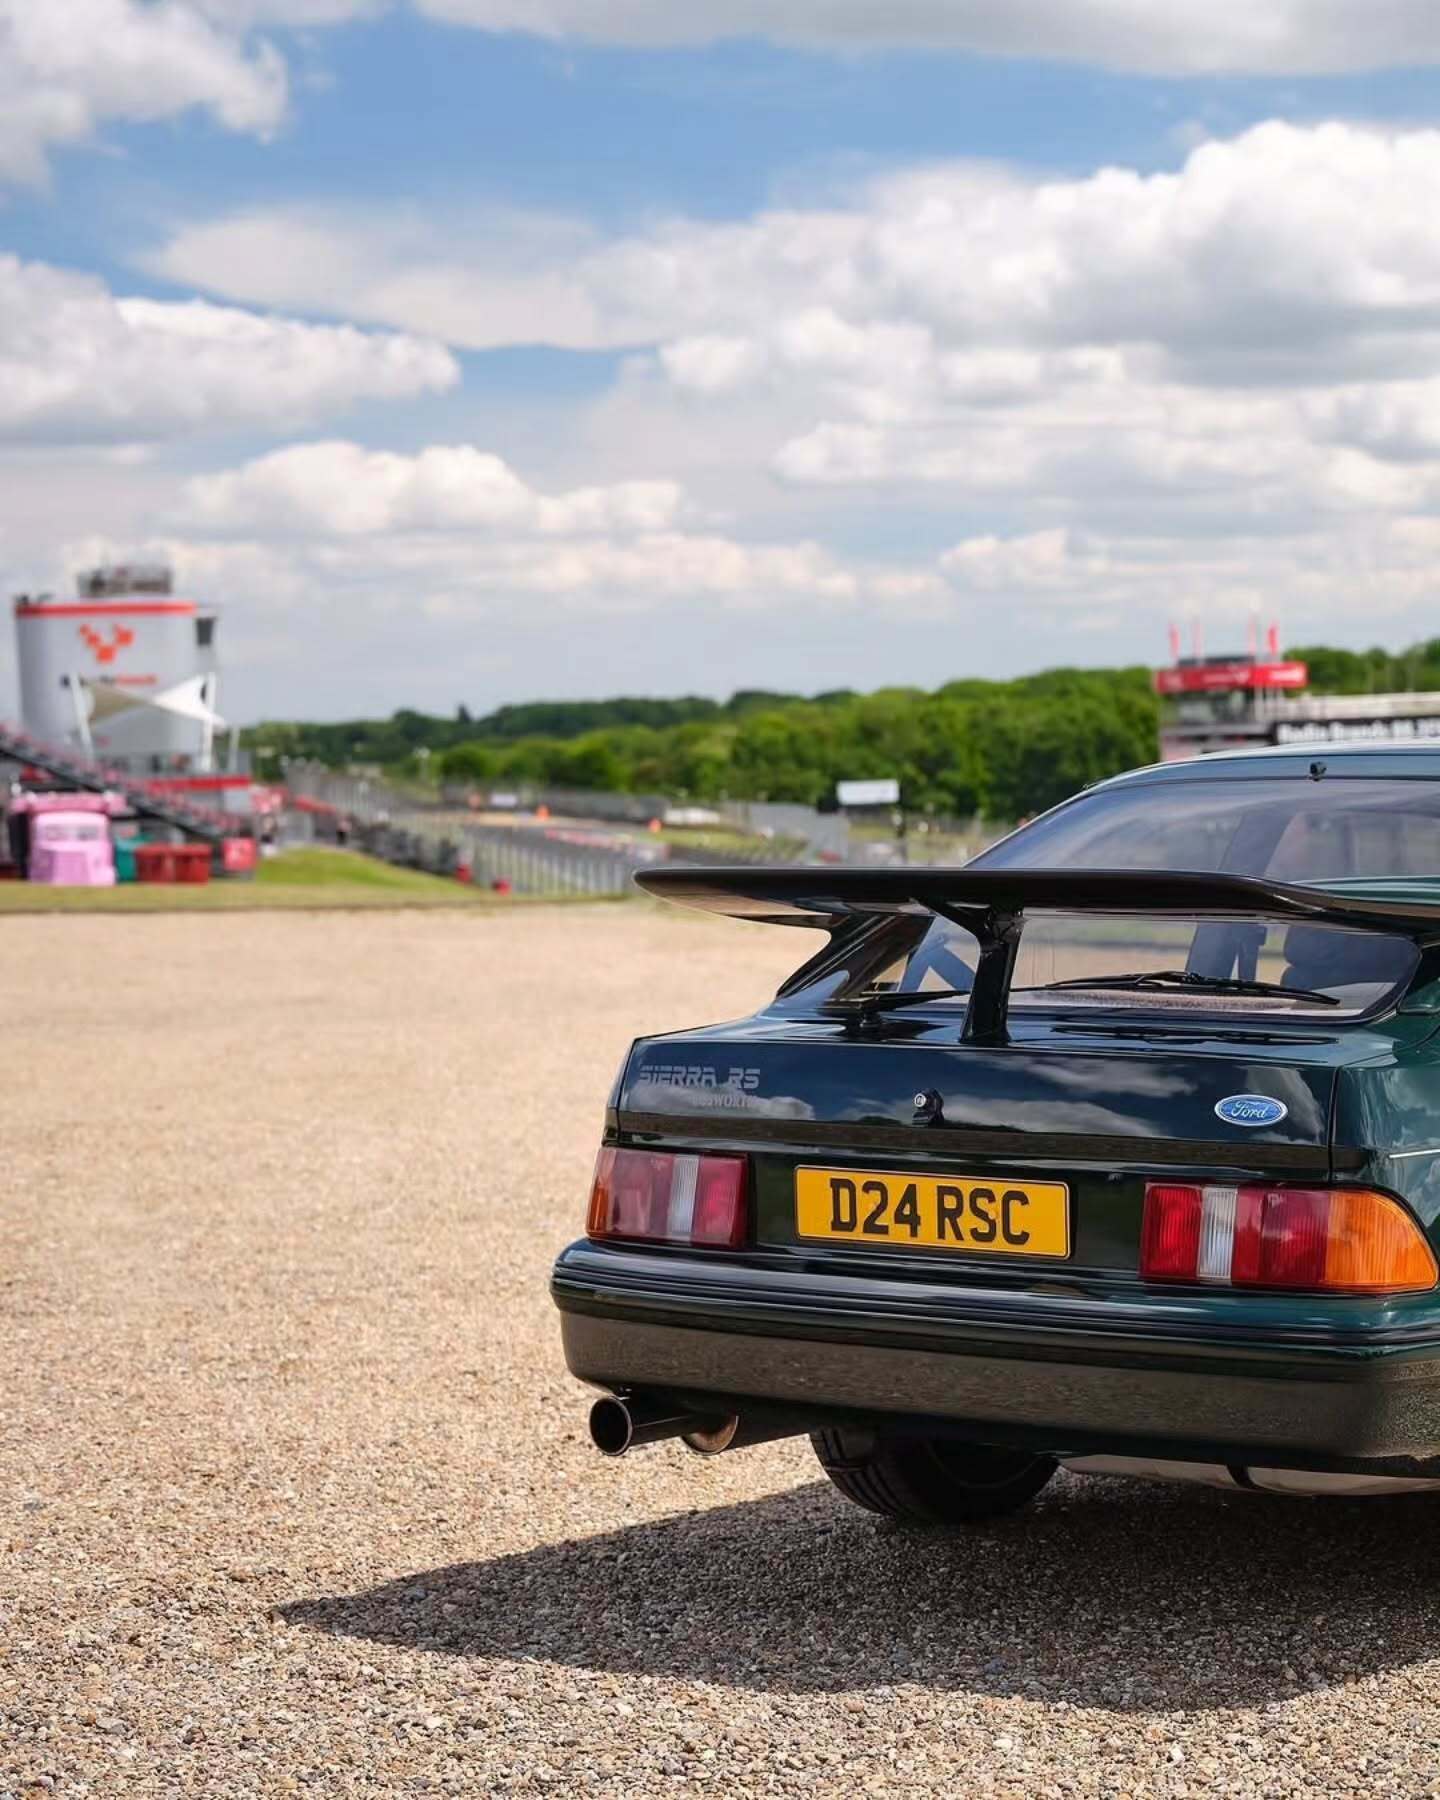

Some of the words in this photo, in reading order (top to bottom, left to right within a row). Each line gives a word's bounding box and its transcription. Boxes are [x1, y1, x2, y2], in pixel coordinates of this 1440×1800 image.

[639, 1065, 716, 1088] SIERRA
[728, 1067, 761, 1090] RS
[1231, 1100, 1270, 1119] Ford
[829, 1177, 922, 1238] D24
[936, 1184, 1031, 1246] RSC
